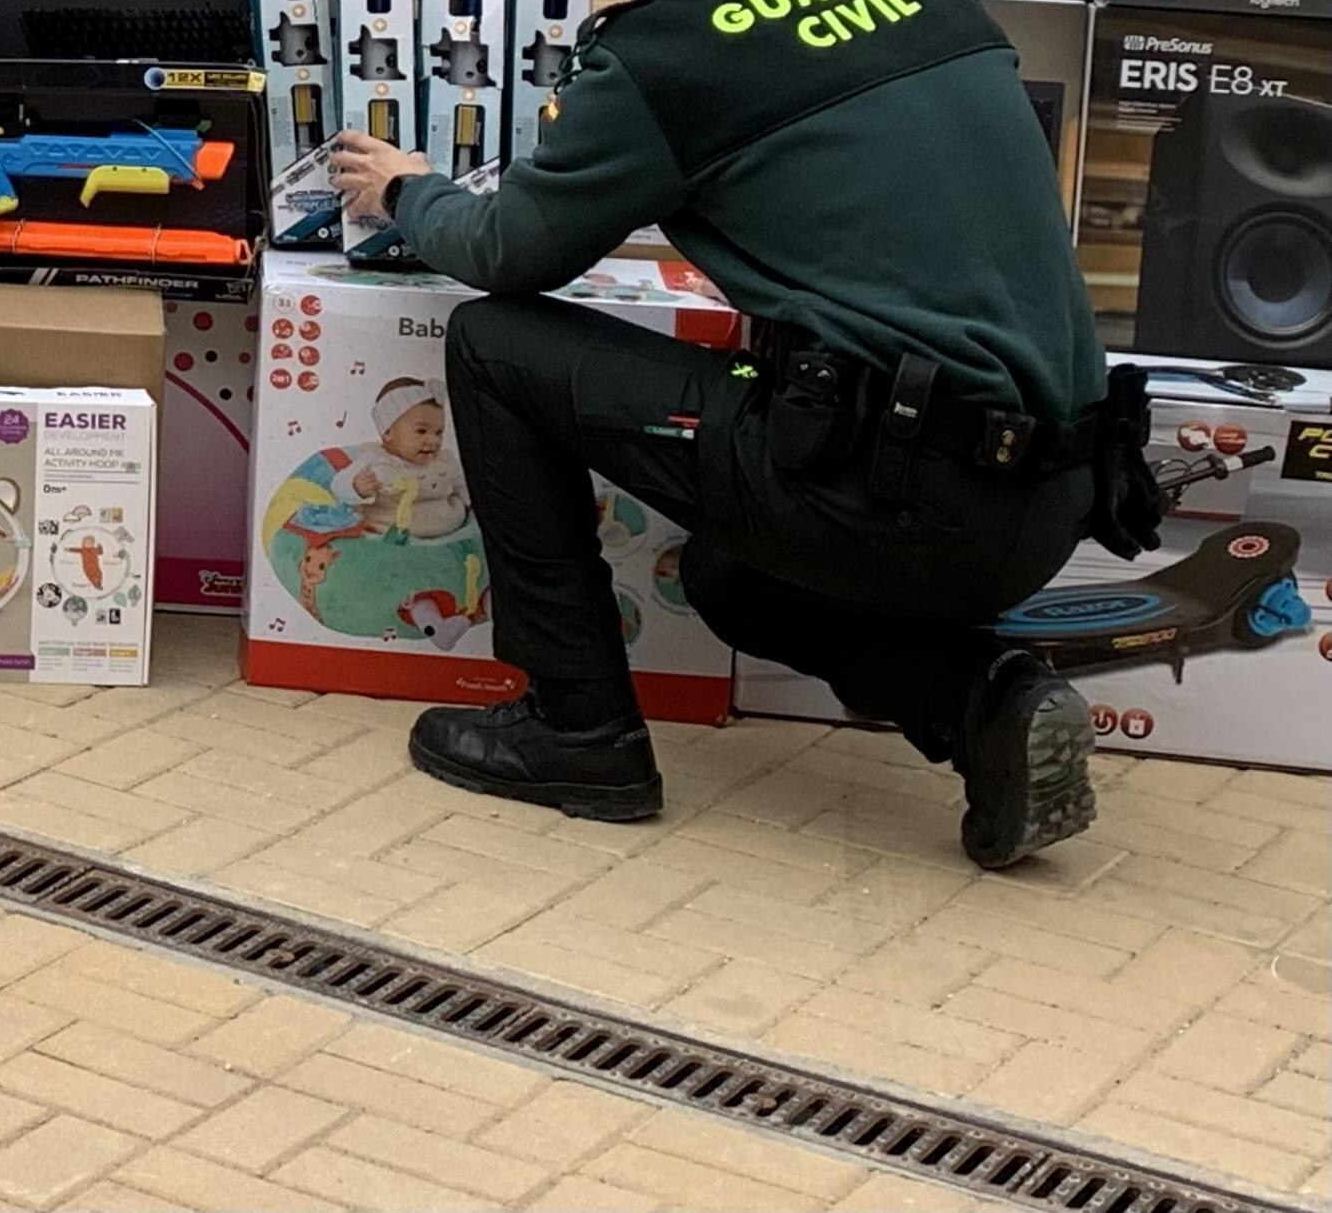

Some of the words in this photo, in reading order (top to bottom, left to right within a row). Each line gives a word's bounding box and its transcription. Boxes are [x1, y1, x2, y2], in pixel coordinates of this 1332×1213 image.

[1145, 36, 1213, 54] PreSonus
[166, 72, 202, 83] 12X
[1120, 59, 1199, 91] ERIS
[1210, 64, 1254, 95] E8
[75, 273, 200, 289] PATHFINDER
[398, 317, 446, 339] Bab
[44, 412, 127, 430] EASIER
[43, 447, 63, 456] ALL
[63, 448, 108, 458] AROUND
[109, 449, 124, 458] ME
[43, 458, 87, 469] ACTIVITY
[88, 459, 119, 470] HOOP
